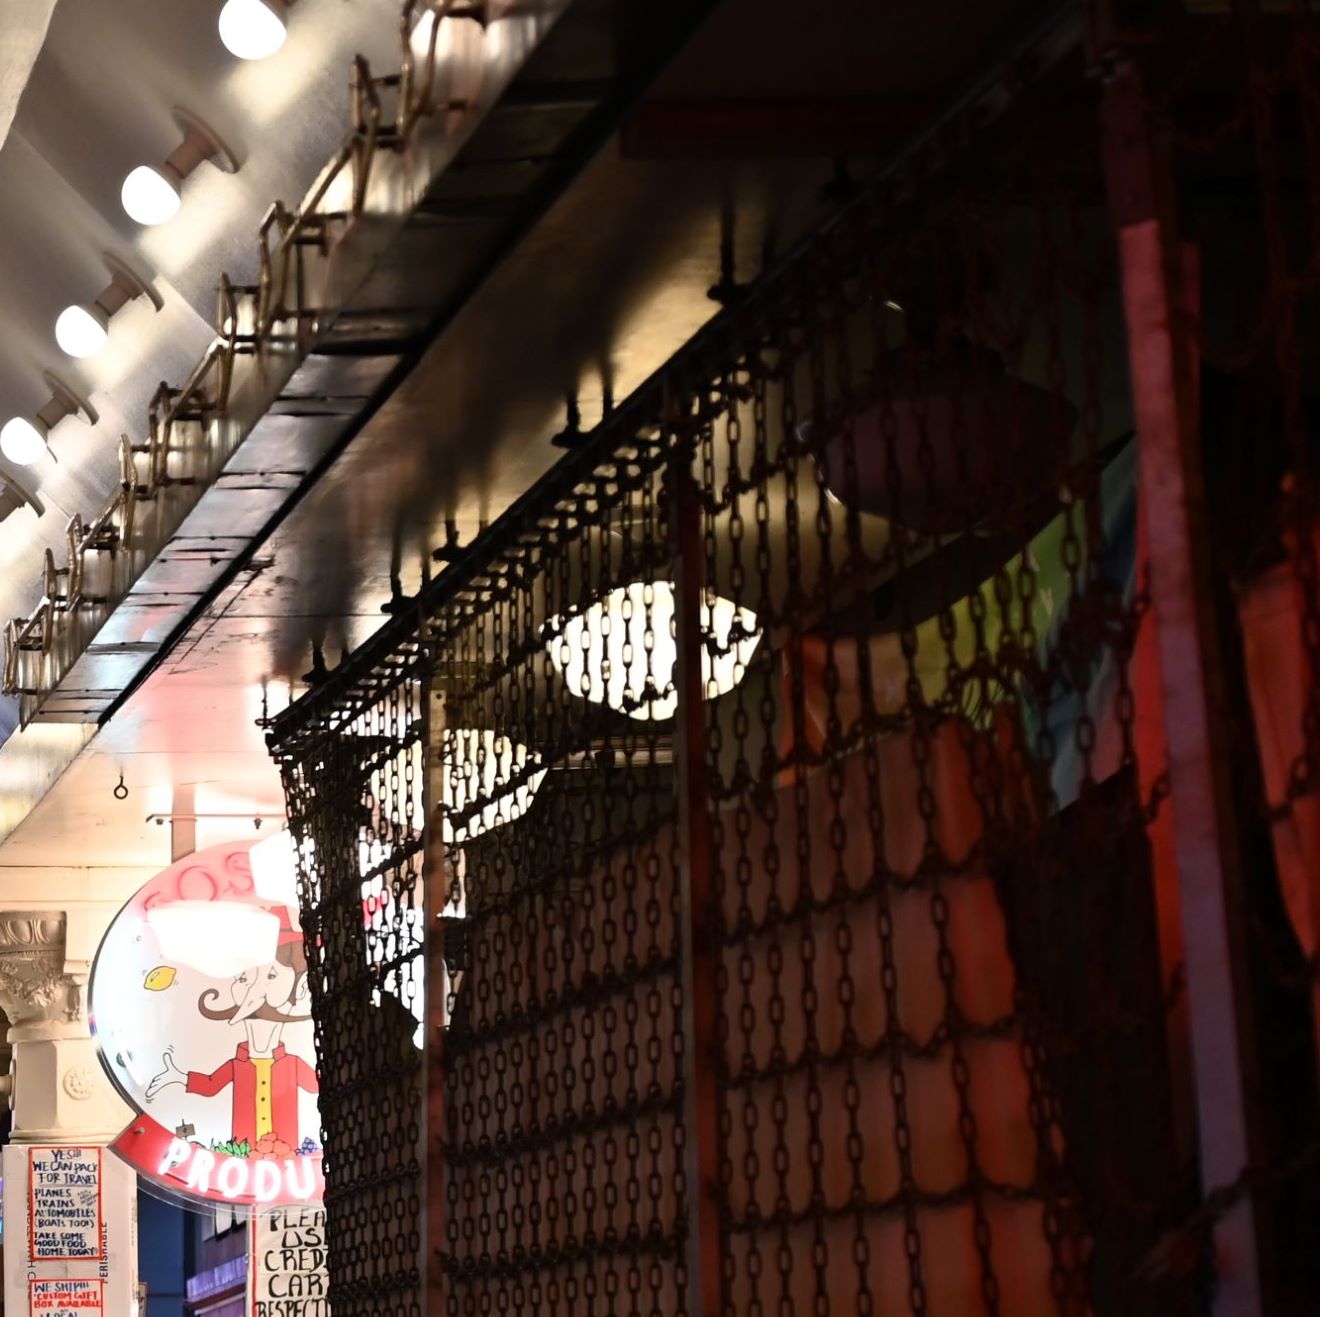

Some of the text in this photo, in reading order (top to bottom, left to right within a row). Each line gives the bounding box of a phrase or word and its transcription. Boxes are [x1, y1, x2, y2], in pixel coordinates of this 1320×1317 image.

[32, 1161, 97, 1174] WE CAN PACK
[158, 1137, 318, 1202] PRODU
[37, 1173, 97, 1184] FOR TRAVEL
[34, 1189, 71, 1198] PLANES
[37, 1199, 75, 1208] TRAINS
[269, 1208, 326, 1232] PLEA
[34, 1232, 84, 1241] TAKE SOME
[62, 1240, 86, 1248] FOOD
[37, 1247, 65, 1256] HOME
[264, 1248, 329, 1273] CRED
[34, 1282, 50, 1293] WE
[268, 1274, 330, 1299] CAR
[36, 1291, 97, 1300] CUSTOM GIFT
[57, 1300, 101, 1308] AVAILABLE
